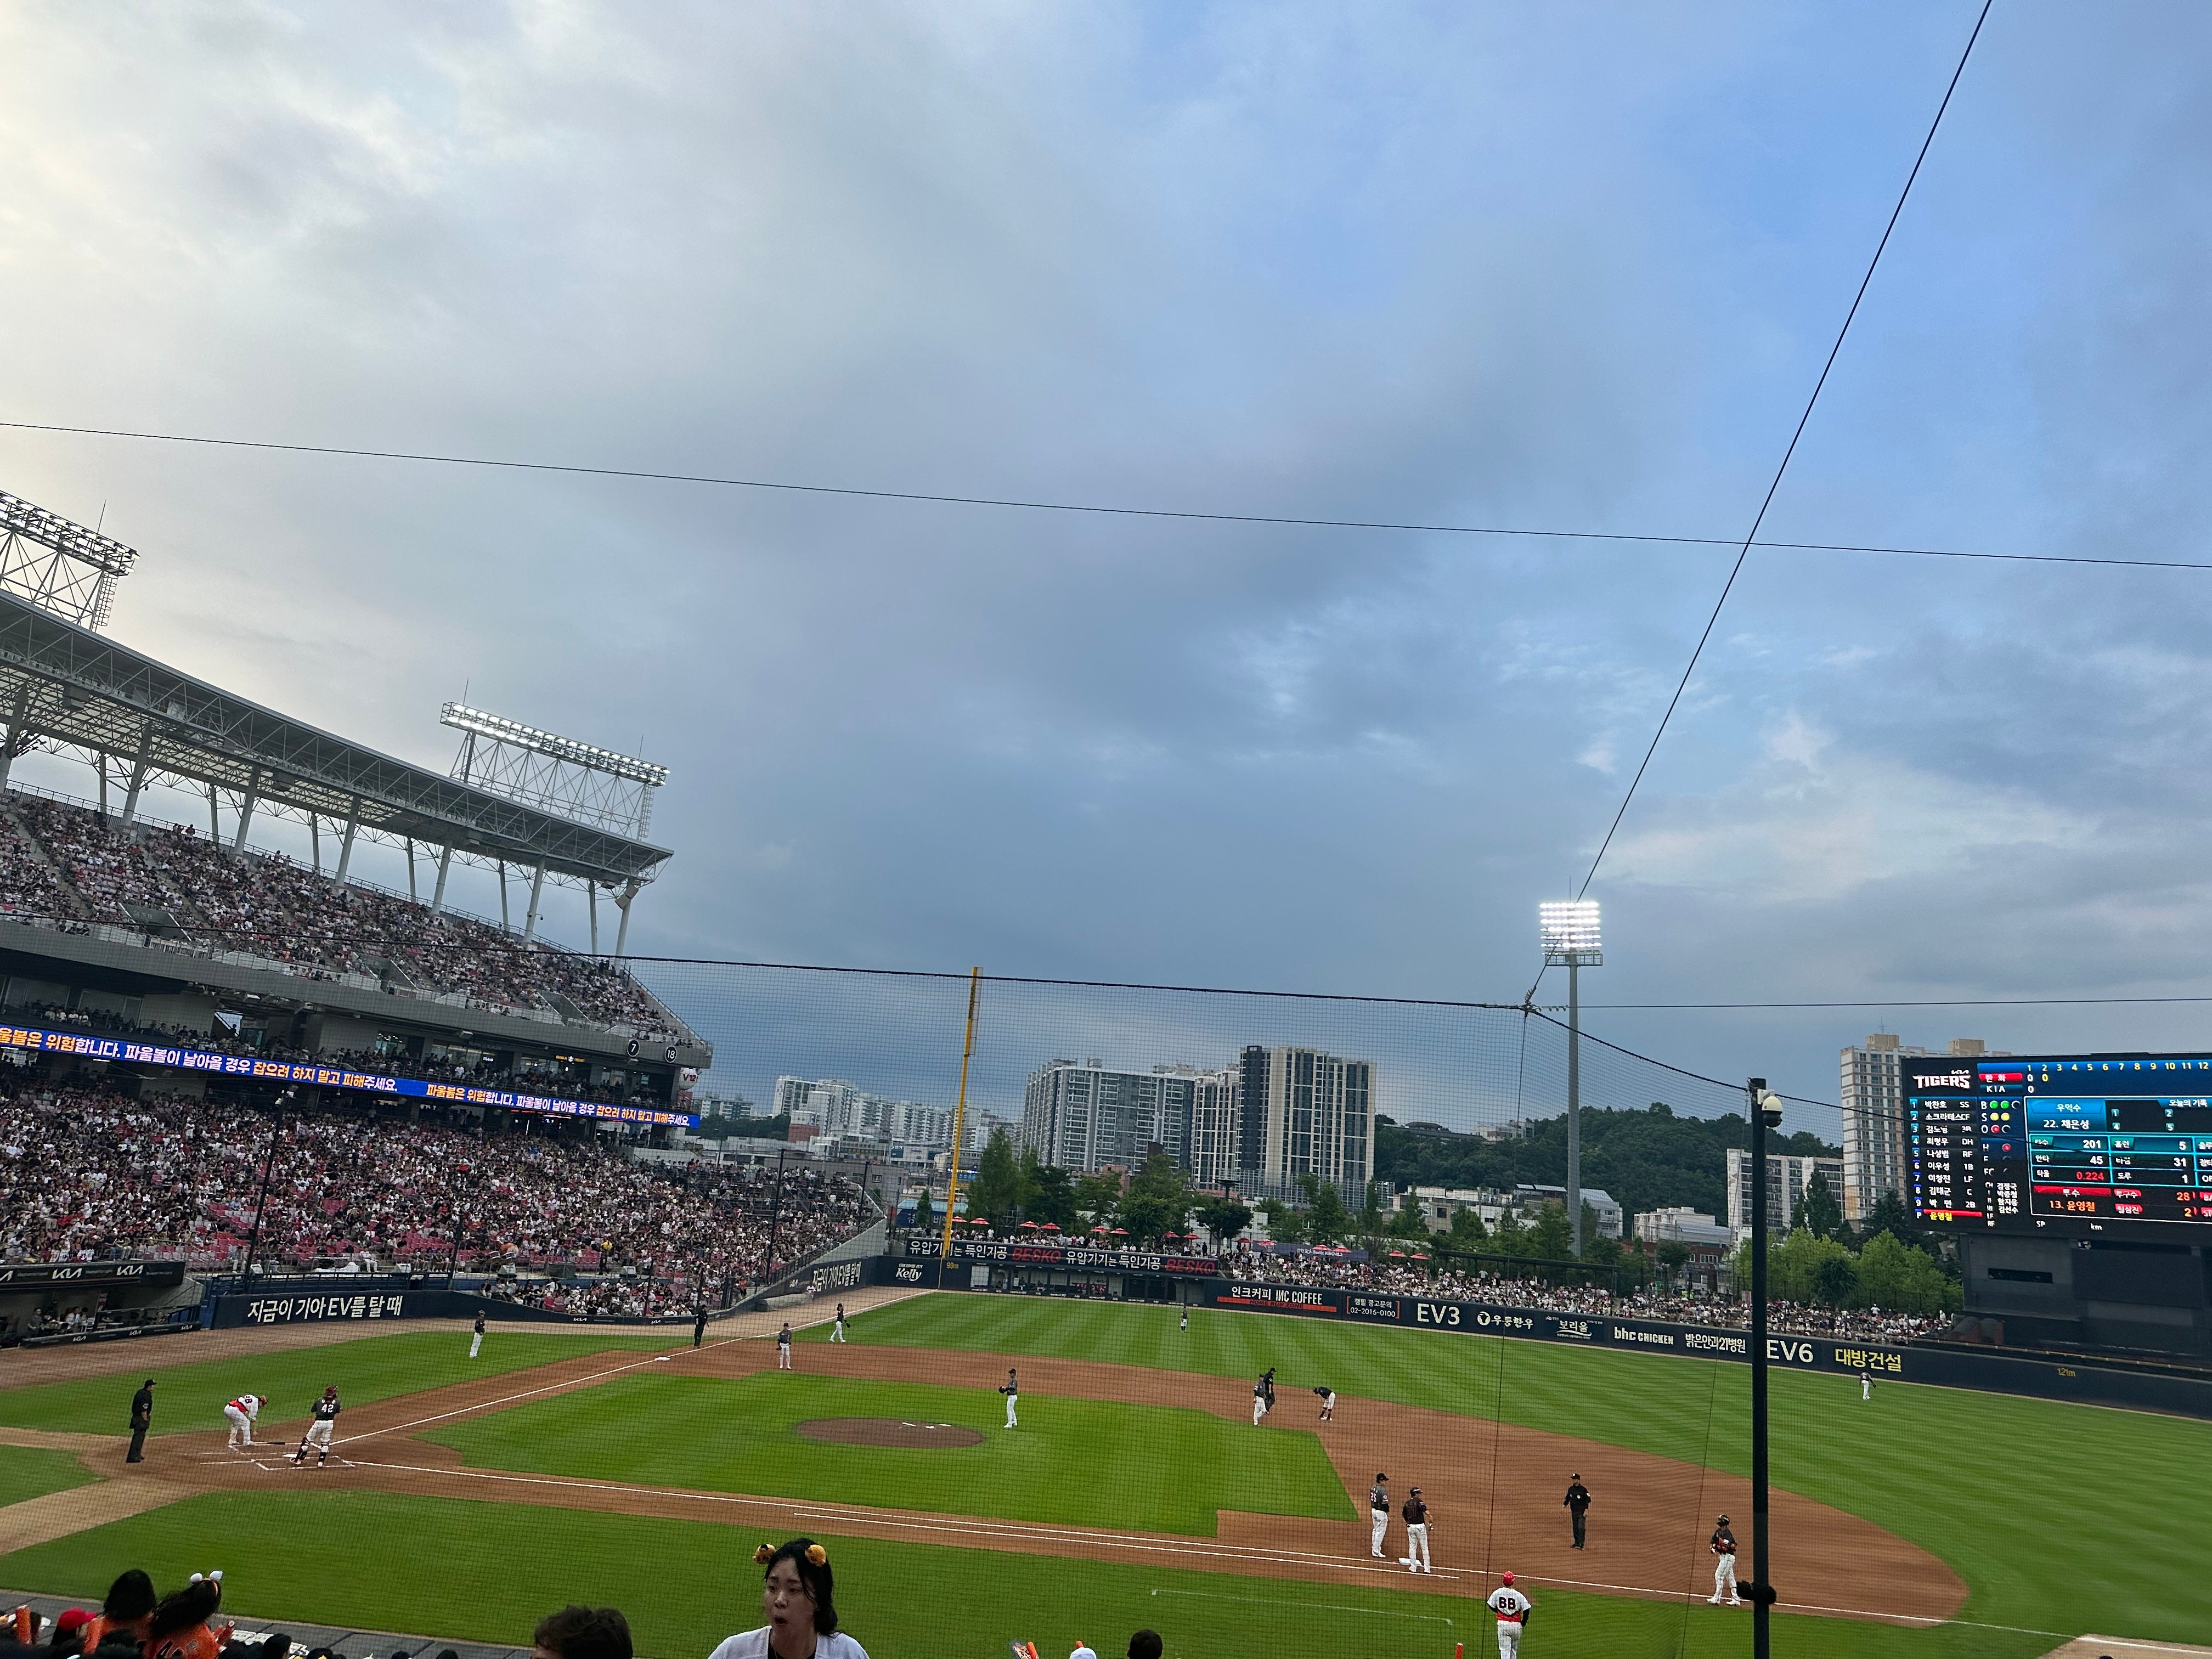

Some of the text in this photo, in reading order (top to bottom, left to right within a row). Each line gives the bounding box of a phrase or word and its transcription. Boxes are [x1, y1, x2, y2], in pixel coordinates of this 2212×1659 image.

[631, 1043, 636, 1052] 7
[667, 1049, 675, 1059] 18
[46, 1034, 120, 1058] 위험합니다.
[125, 1045, 180, 1065] 파울볼이
[183, 1052, 223, 1070] 날아올
[225, 1057, 251, 1074] 경우
[253, 1061, 289, 1078] 잡으려
[292, 1066, 315, 1082] 하지
[318, 1070, 340, 1085] 말고
[683, 1074, 697, 1082] V12
[1912, 1075, 1971, 1088] TIGERS
[2027, 1074, 2049, 1082] 0 0
[2028, 1085, 2034, 1093] 0
[426, 1084, 465, 1100] 파울볼은
[467, 1089, 514, 1106] 위험합니다.
[516, 1096, 550, 1110] 파울볼이
[552, 1099, 577, 1114] 날아올
[579, 1103, 595, 1115] 경우
[621, 1109, 636, 1120] 하지
[1925, 1101, 1947, 1109] 박찬호
[2169, 1099, 2208, 1107] 오늘의 기록
[2057, 1103, 2081, 1112] 우익수
[1982, 1113, 1987, 1121] S
[2043, 1119, 2089, 1130] 22. 채은성
[2083, 1139, 2101, 1149] 201
[2114, 1140, 2186, 1150] 홈런 5
[1927, 1149, 1949, 1159] 나성범
[2090, 1156, 2103, 1165] 45
[2174, 1158, 2187, 1167] 31
[1927, 1162, 1950, 1171] 이우성
[1928, 1174, 1950, 1183] 이창진
[2076, 1171, 2104, 1181] 0.224
[2182, 1175, 2188, 1183] 1
[1929, 1187, 1951, 1196] 김태군
[2063, 1188, 2080, 1198] 투수
[2115, 1189, 2191, 1201] 투구수 28
[2050, 1200, 2096, 1212] 13. 윤영철
[2184, 1208, 2192, 1217] 2
[965, 1244, 1007, 1260] 득인기공
[1012, 1247, 1062, 1263] BESKO
[1066, 1251, 1215, 1274] 유압기기는 득인기공 BESKO
[895, 1268, 922, 1282] Kelly
[1231, 1286, 1322, 1305] 인크커피 INC COFFEE
[1368, 1299, 1392, 1308] 광고문의
[247, 1295, 403, 1323] 지금이 기아 EV를 탈 때
[1350, 1307, 1396, 1317] 02-2016-0100
[1417, 1303, 1460, 1325] EV3
[1614, 1327, 1673, 1345] bhc CHICKEN
[1685, 1333, 1746, 1353] 밝은안과21병원
[1767, 1339, 1814, 1363] EV6
[1835, 1348, 1902, 1372] 대방건설
[2057, 1367, 2076, 1378] 121m
[321, 1404, 334, 1413] 42
